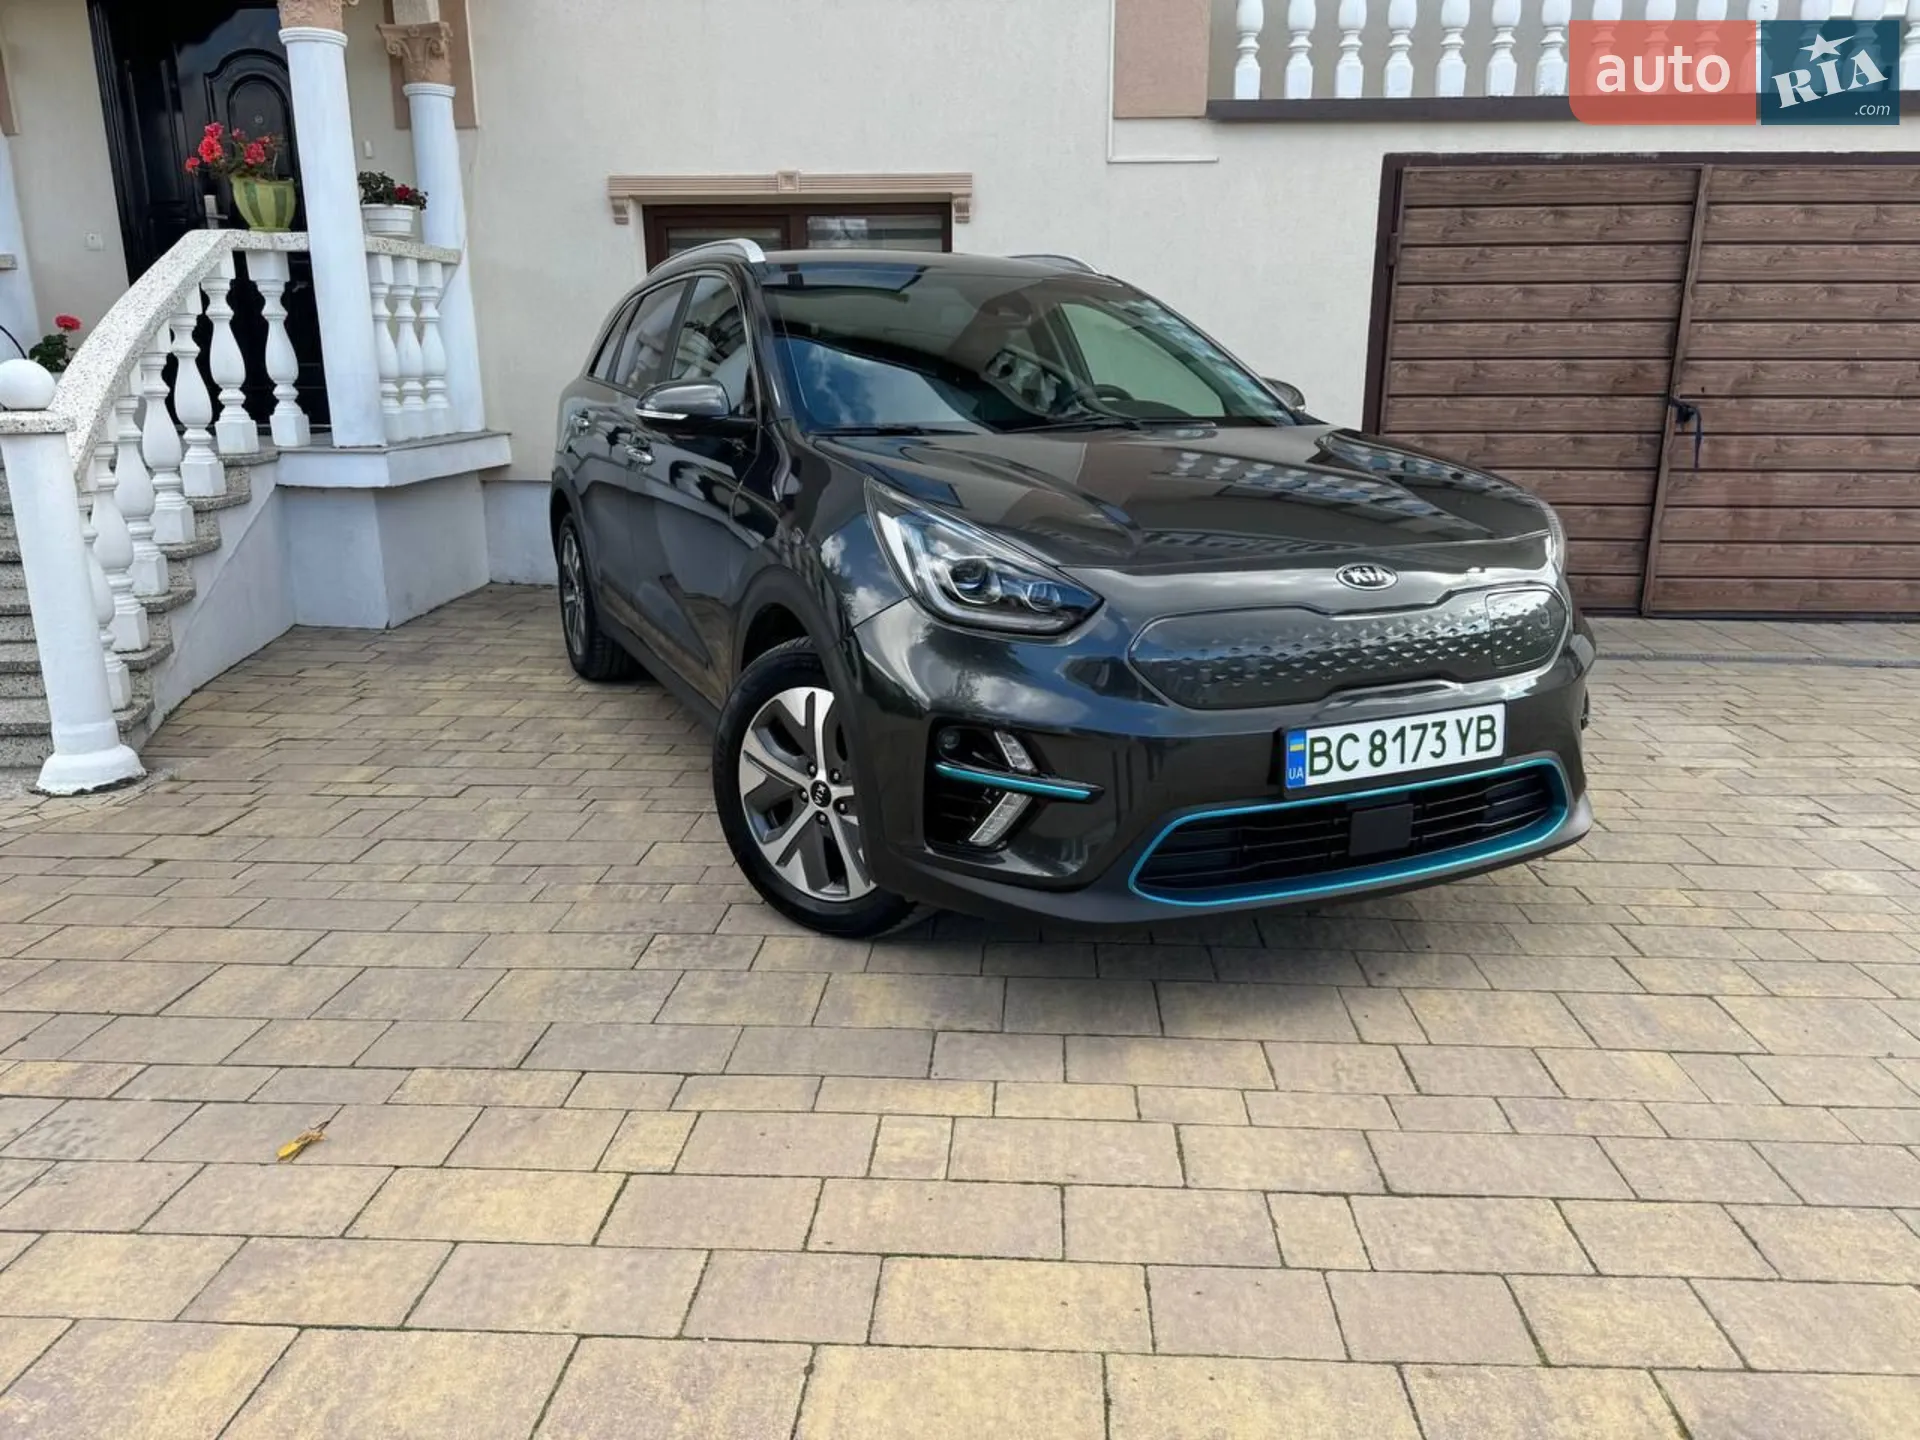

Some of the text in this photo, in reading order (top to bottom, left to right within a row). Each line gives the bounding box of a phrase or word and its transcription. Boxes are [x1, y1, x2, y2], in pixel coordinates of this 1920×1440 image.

[1308, 714, 1497, 777] BC 8173 YB
[1288, 766, 1304, 780] UA
